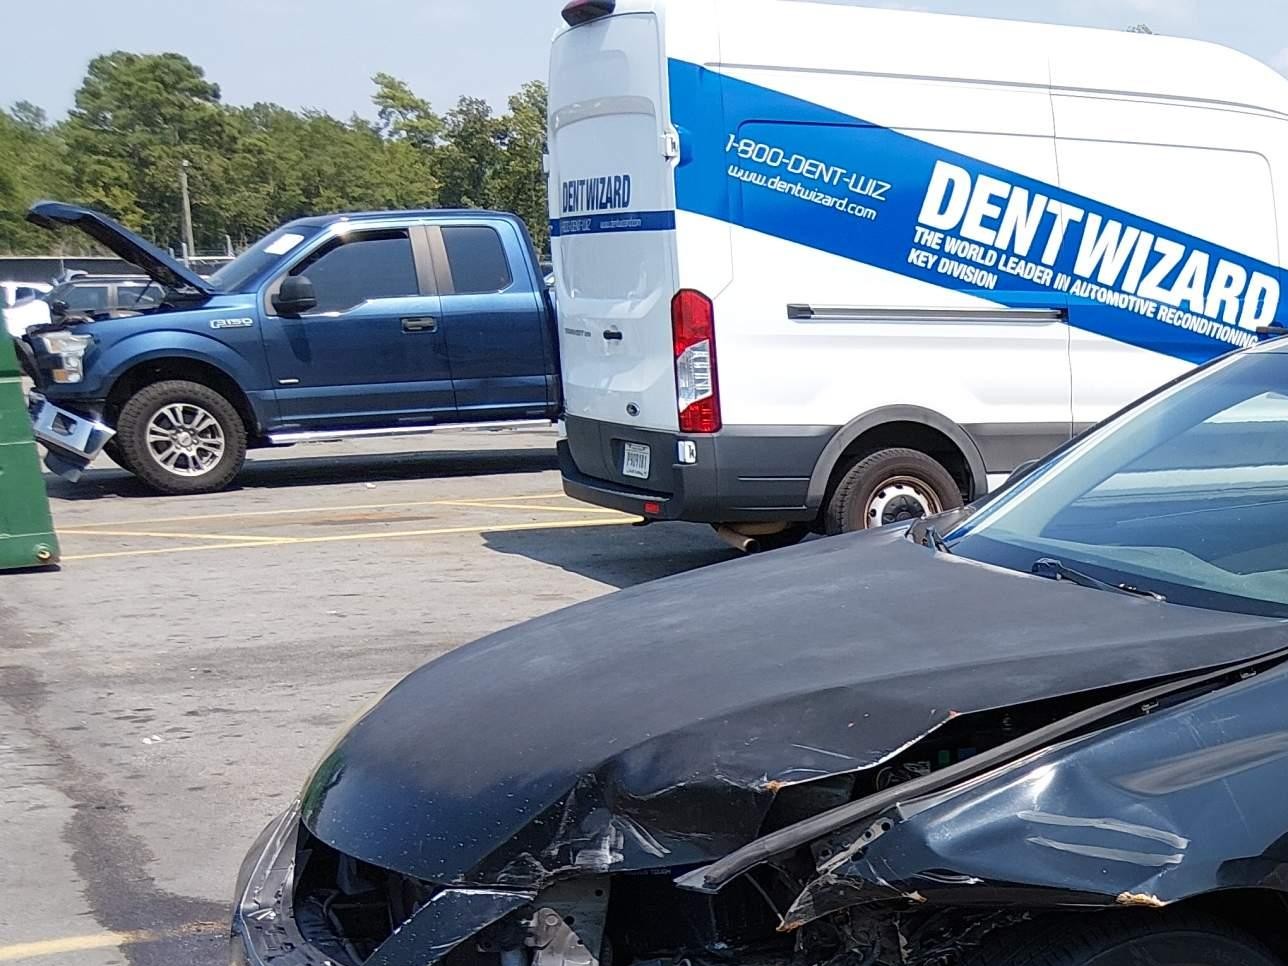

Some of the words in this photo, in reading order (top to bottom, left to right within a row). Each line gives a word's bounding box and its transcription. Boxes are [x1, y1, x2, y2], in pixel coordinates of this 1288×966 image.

[725, 133, 892, 201] 1-800-DENT-WIZ
[727, 164, 877, 220] www.dentwizard.com
[908, 248, 938, 269] KEY
[937, 258, 998, 290] DIVISION
[913, 225, 944, 250] THE
[944, 236, 997, 267] WORLD
[998, 254, 1053, 286] LEADER
[1053, 273, 1071, 292] IN
[1070, 280, 1157, 318] AUTOMOTIVE
[1157, 305, 1259, 348] RECONDITIONING
